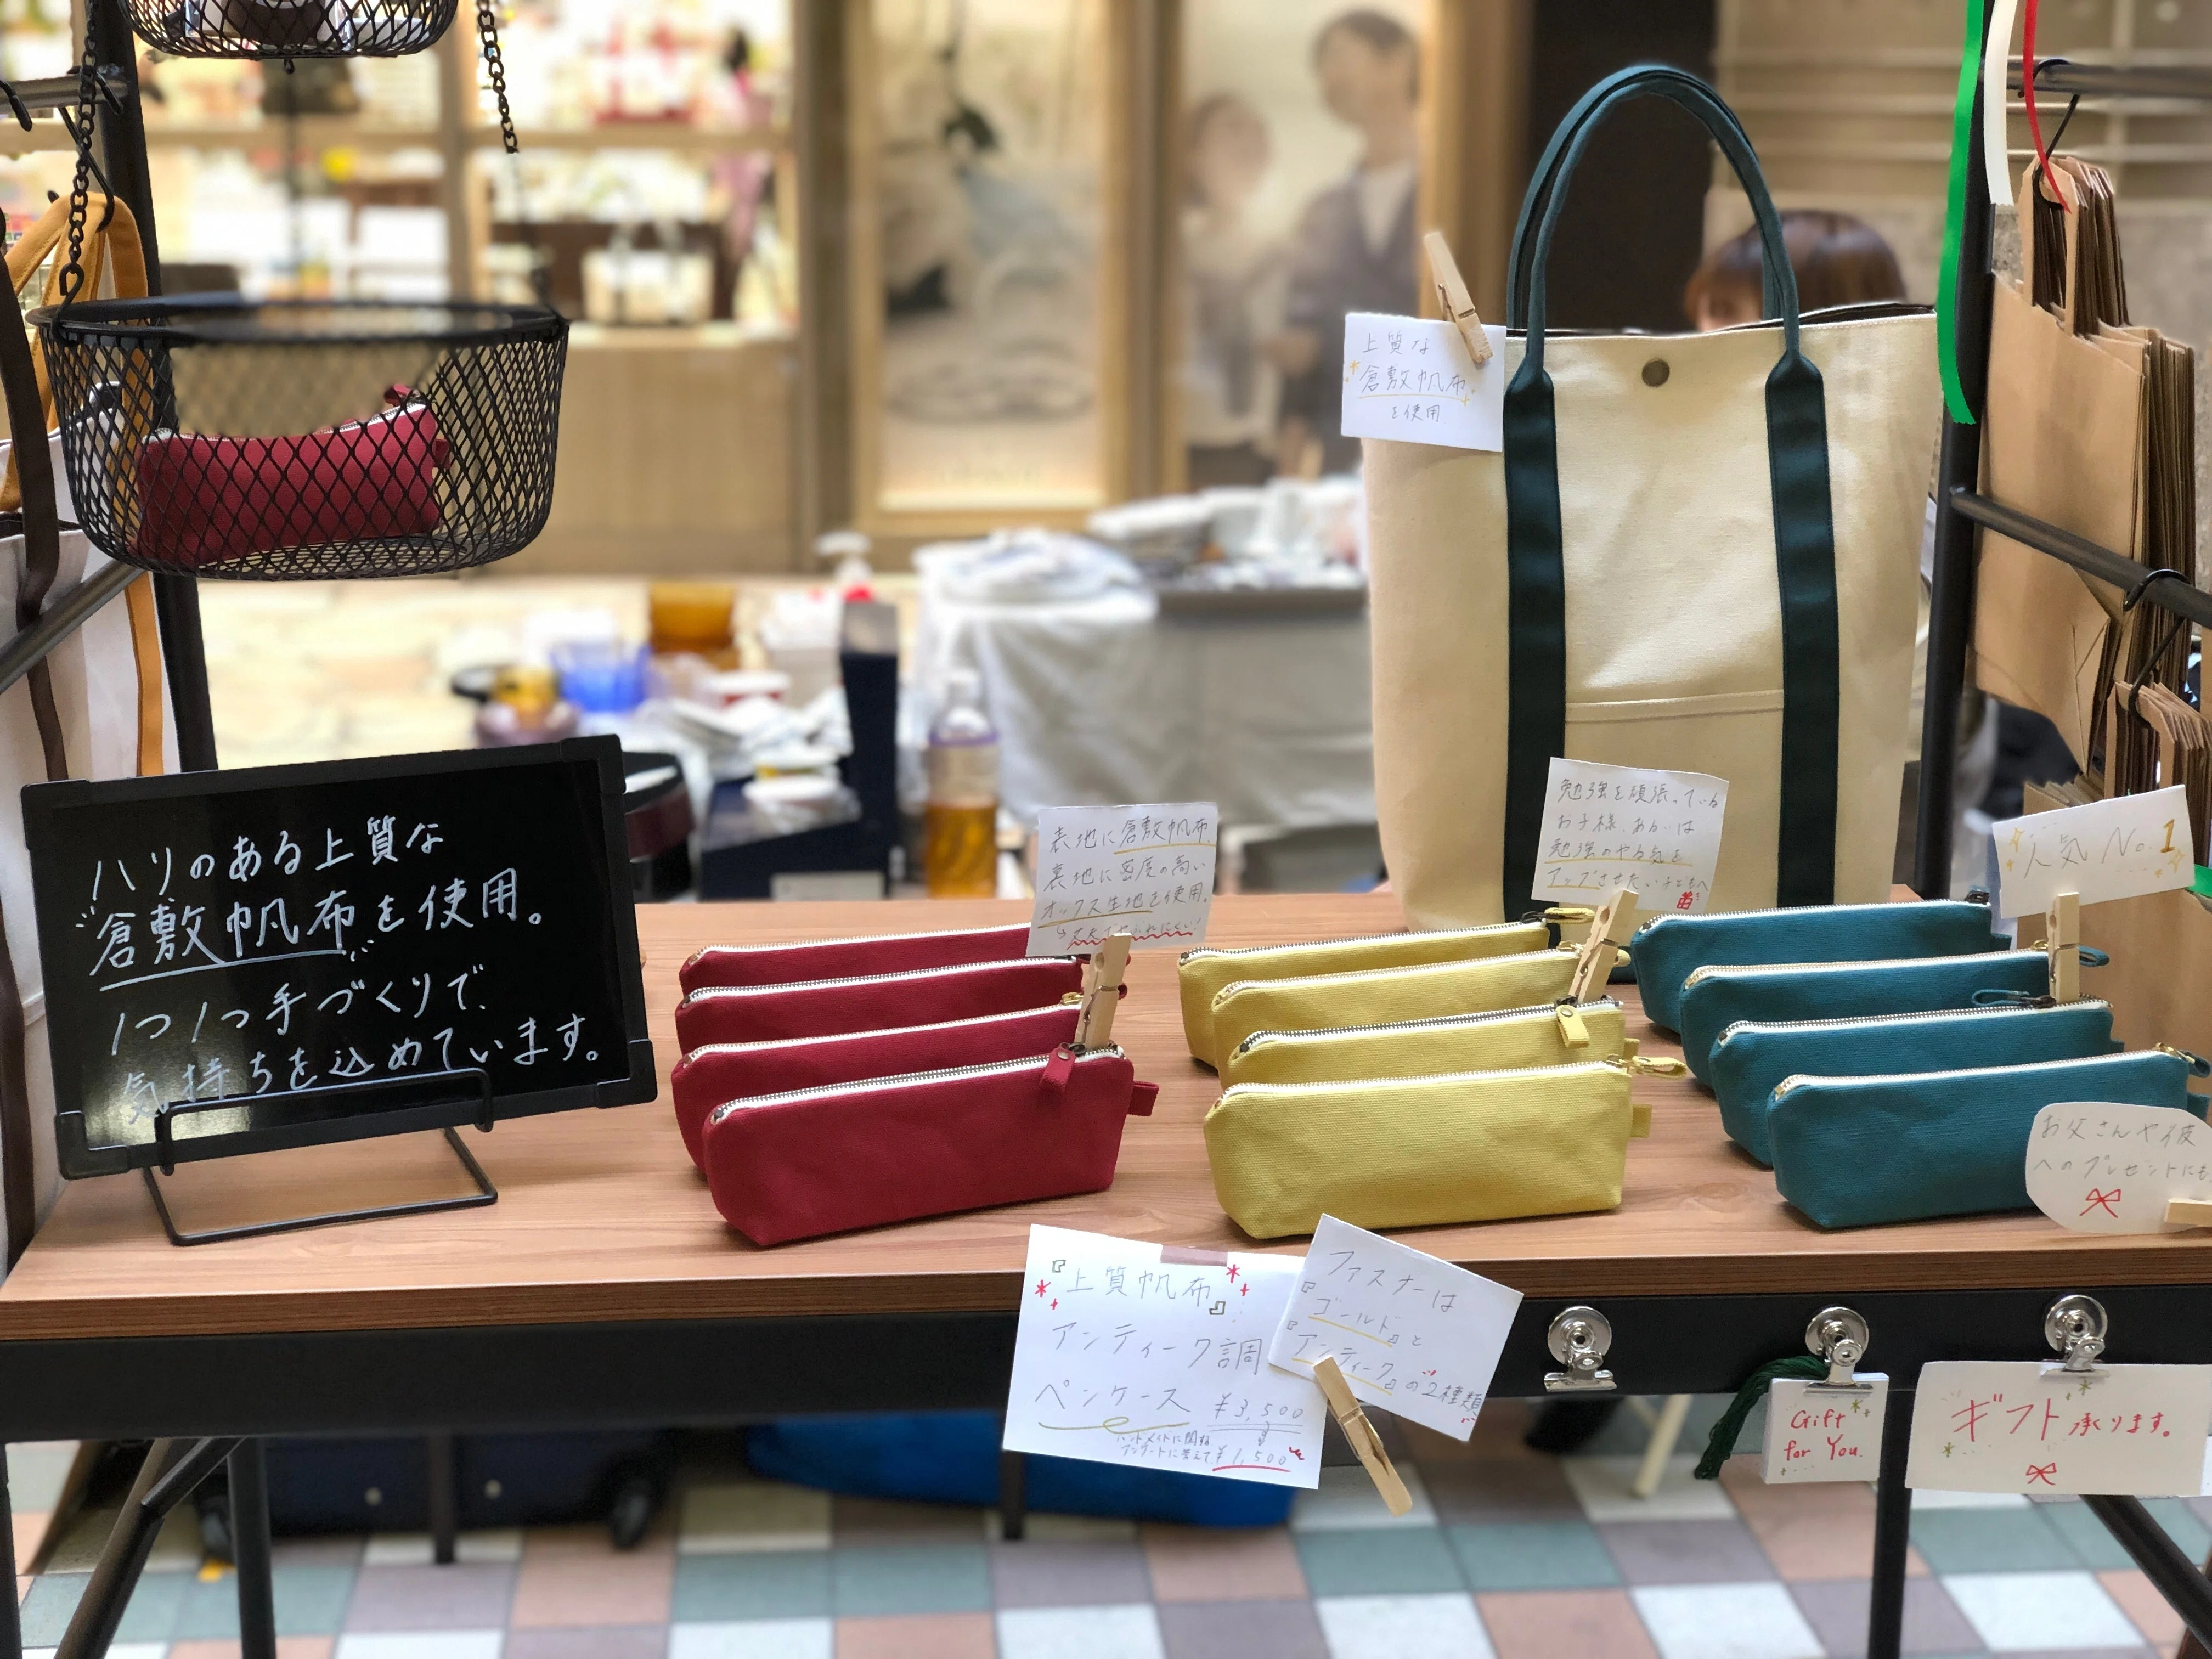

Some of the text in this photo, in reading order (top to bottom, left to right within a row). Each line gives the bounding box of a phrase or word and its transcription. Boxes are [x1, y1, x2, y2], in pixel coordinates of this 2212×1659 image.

[1362, 331, 1429, 355] 上質な
[1359, 364, 1466, 396] 倉敷帆布
[1558, 779, 1719, 808] 勉強を頑張っている
[92, 815, 445, 901] ハリのある上質な
[1548, 838, 1682, 865] 勉強のやる気を
[2023, 833, 2088, 879] 人気
[1043, 854, 1205, 892] 裏地に密度の高い
[1548, 867, 1709, 891] アップさせたい子どもへ
[1041, 882, 1207, 921] オックス生地を使用。
[123, 1013, 600, 1124] 気持ちを込めています。
[2041, 1114, 2196, 1148] お父さんや彼
[1328, 1251, 1458, 1312] ファスナーは
[1052, 1322, 1262, 1375] アンティーク調
[1035, 1379, 1191, 1413] ペンケース
[1790, 1409, 1846, 1429] Gift
[1951, 1393, 2171, 1442] ギフト承ります。
[1784, 1440, 1812, 1461] for
